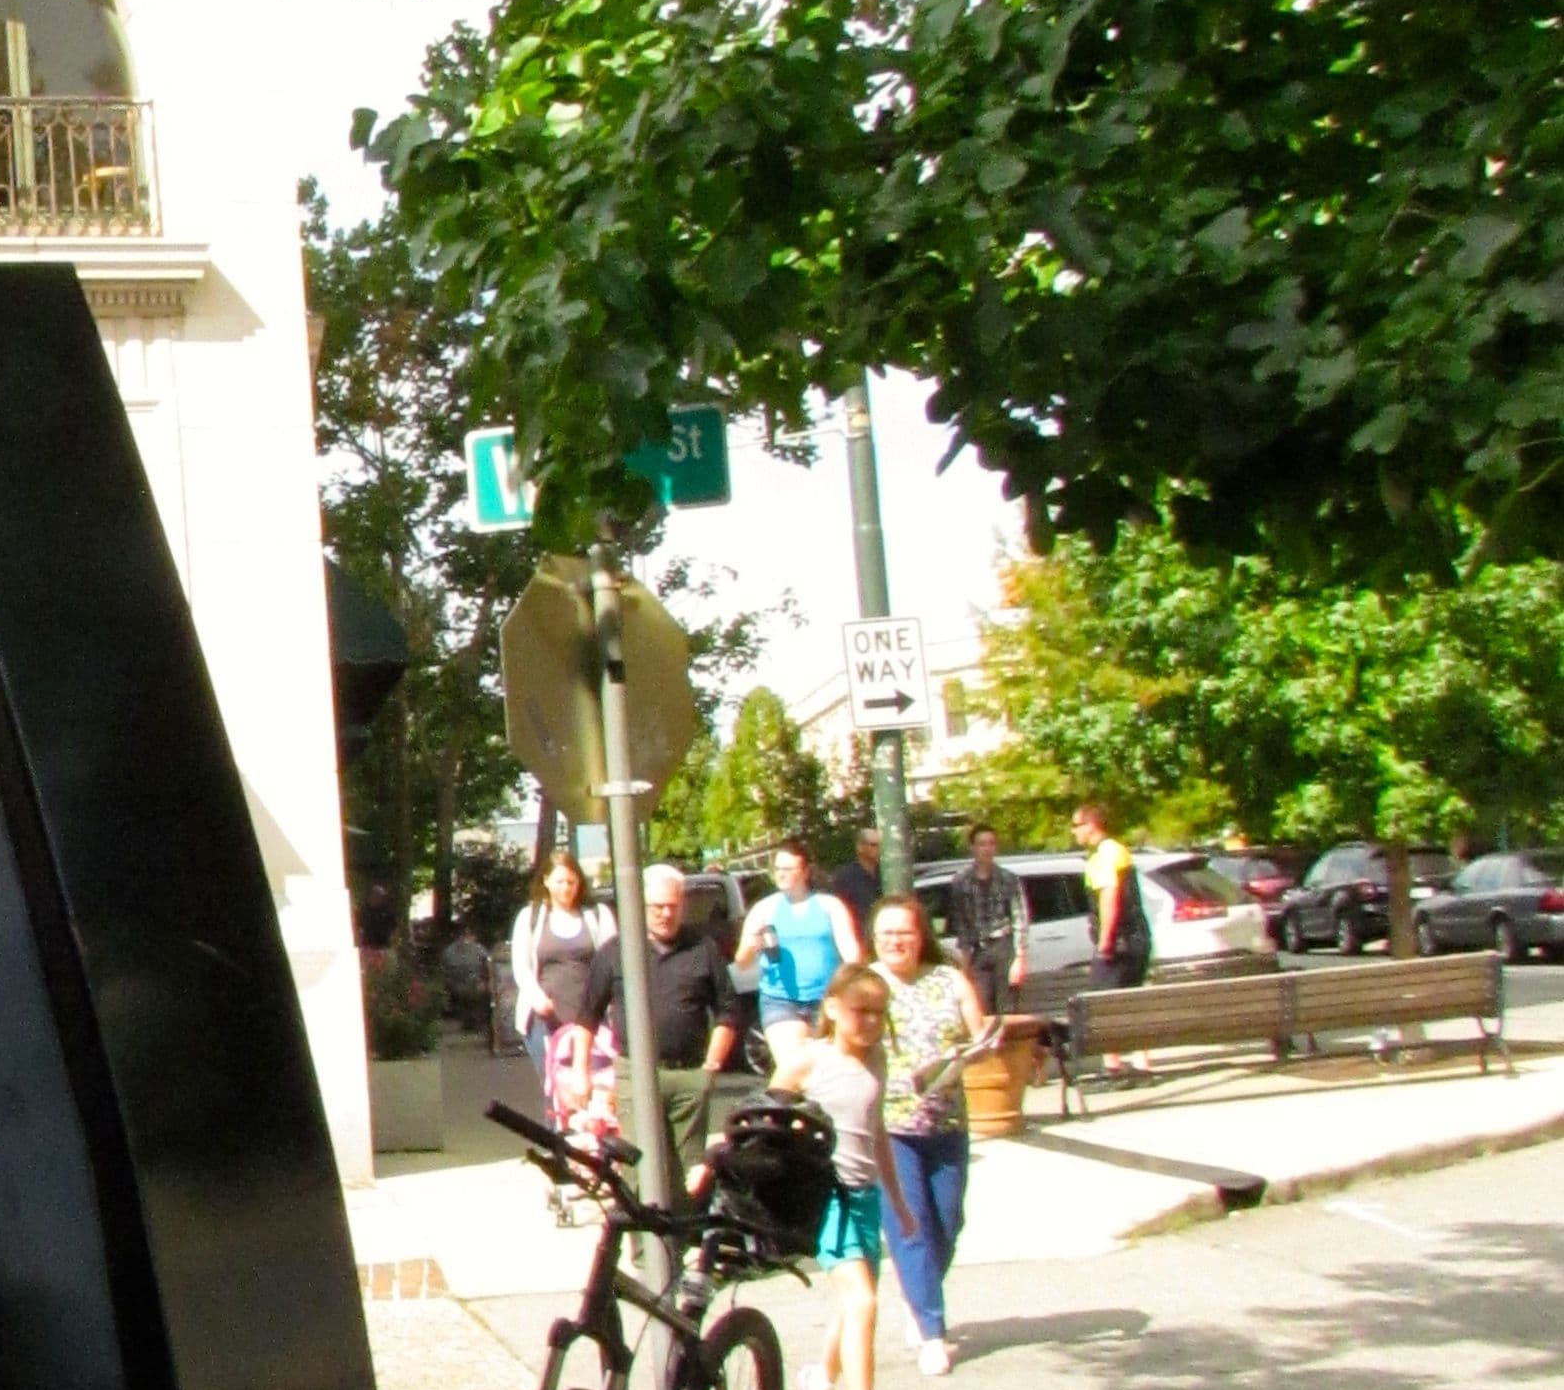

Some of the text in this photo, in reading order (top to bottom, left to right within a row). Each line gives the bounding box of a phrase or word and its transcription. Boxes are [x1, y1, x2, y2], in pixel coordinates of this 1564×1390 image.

[667, 423, 704, 462] St
[854, 628, 912, 654] ONE
[856, 657, 915, 683] WAY
